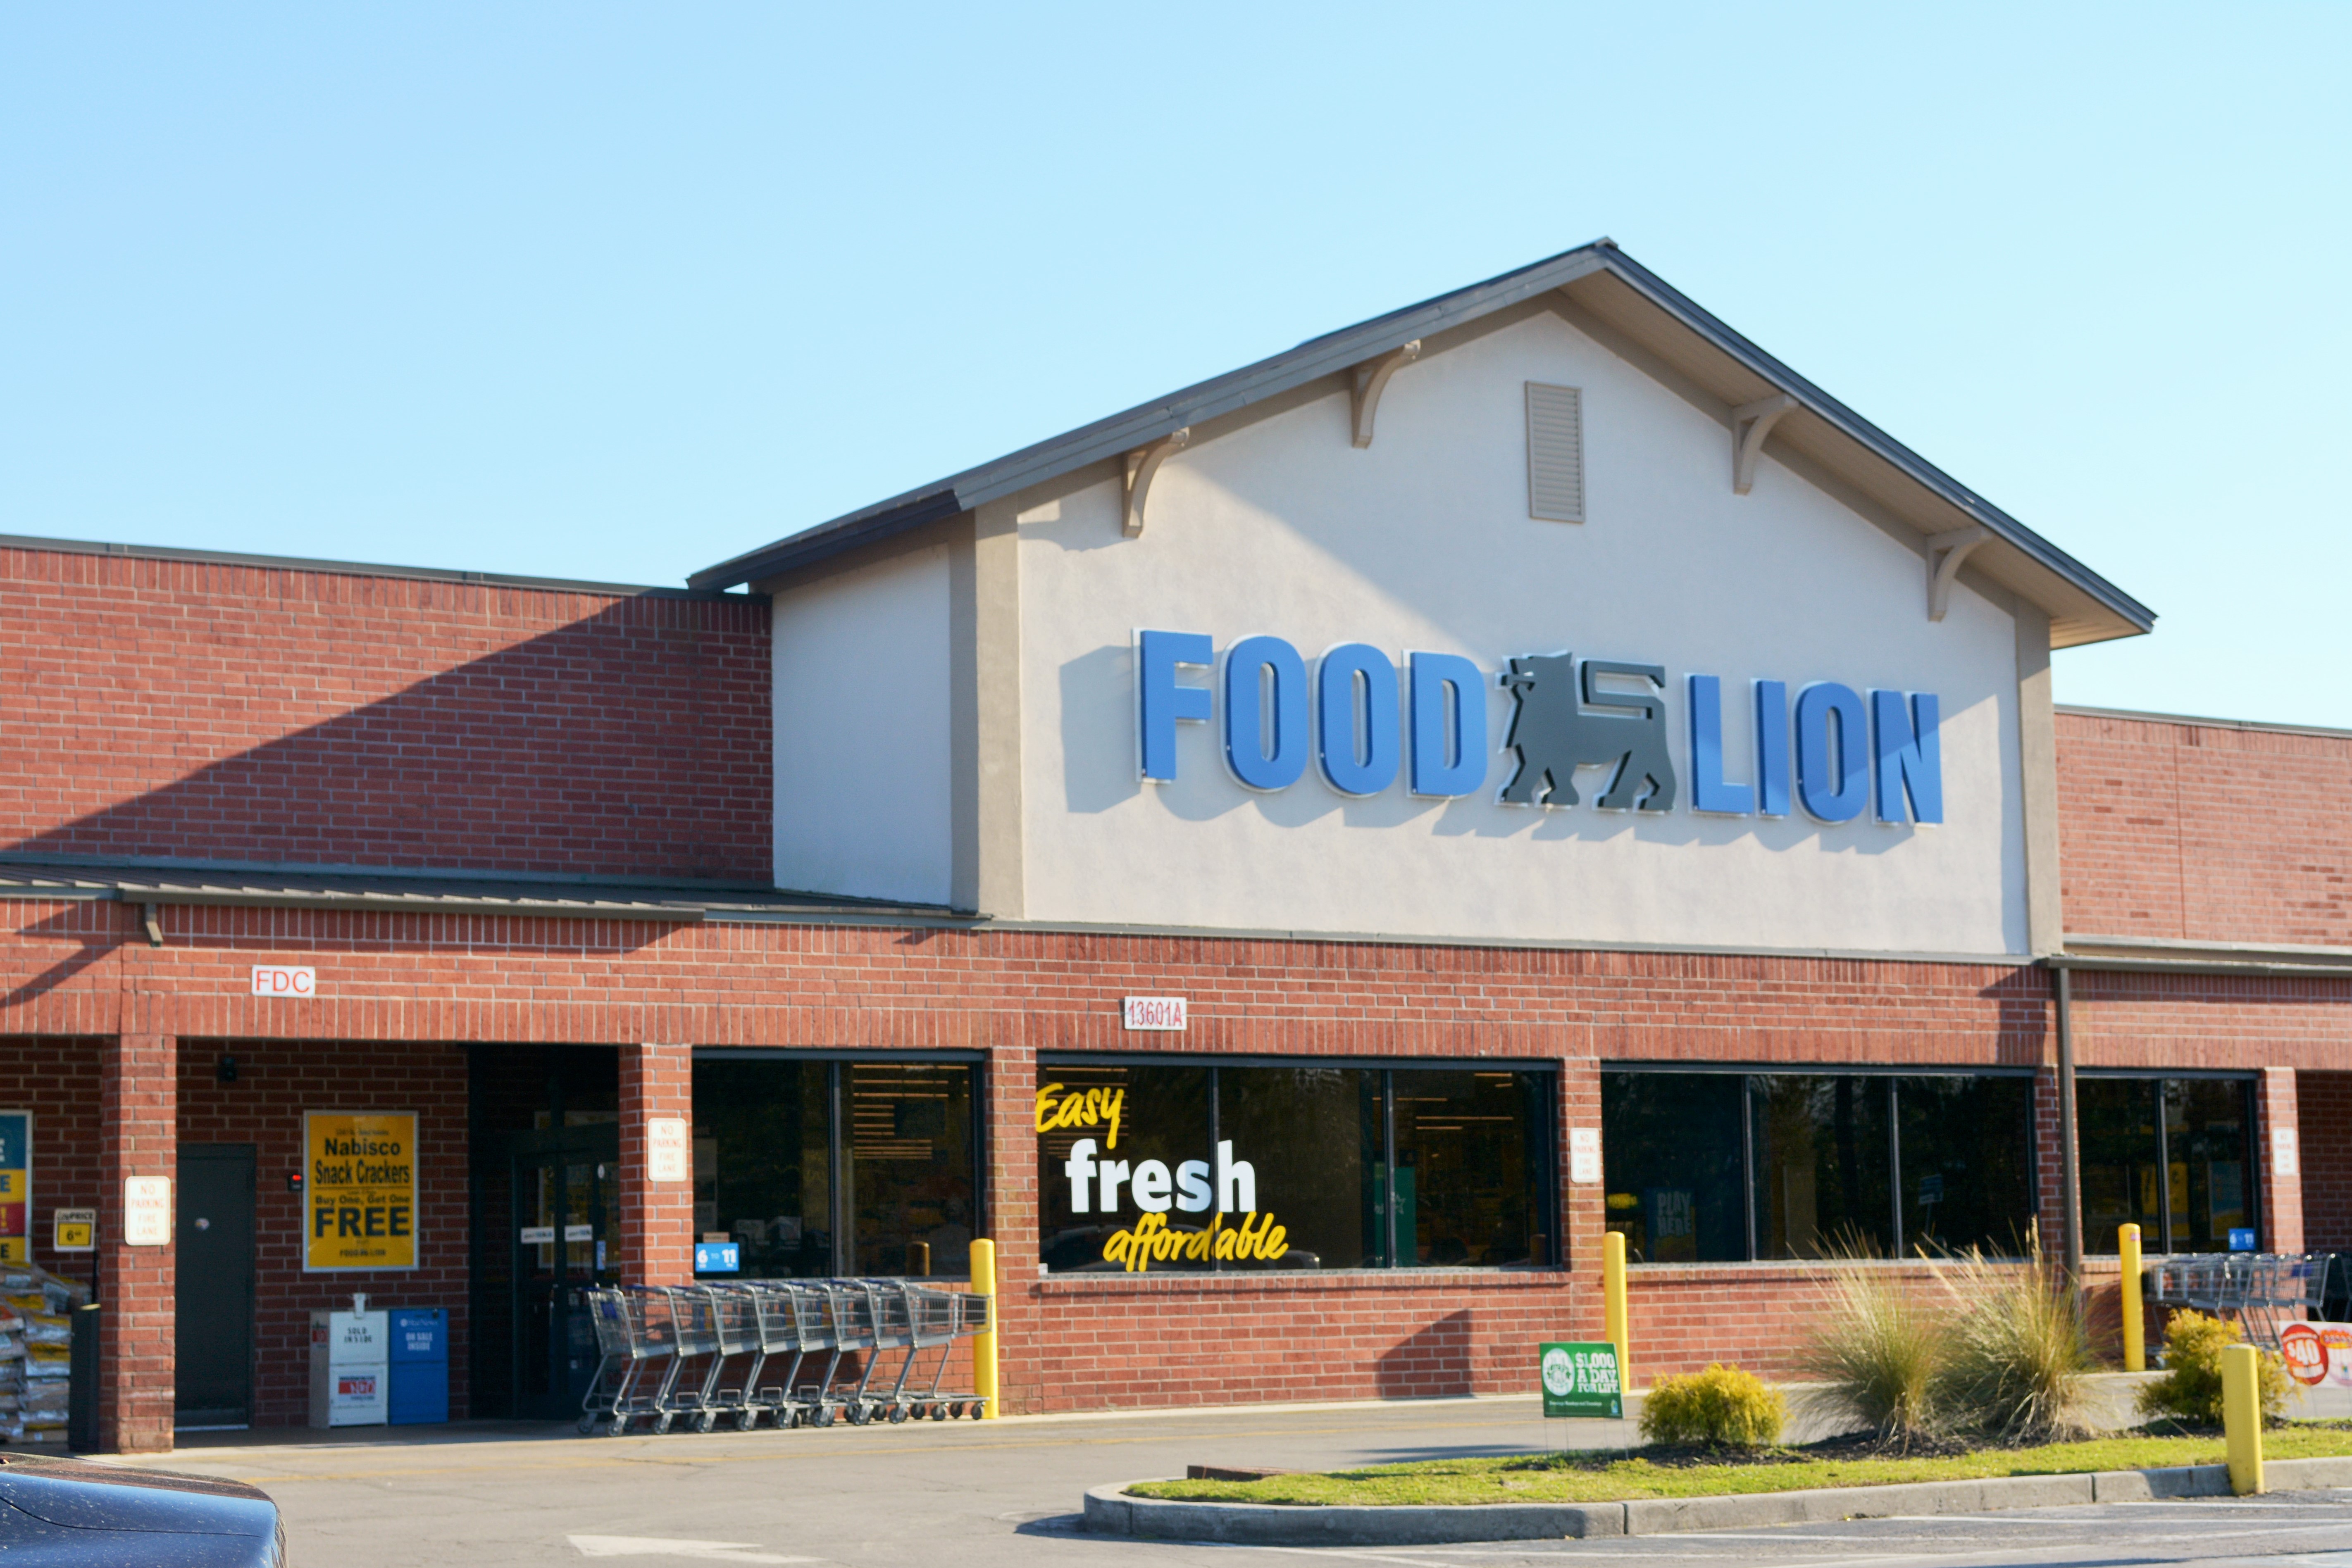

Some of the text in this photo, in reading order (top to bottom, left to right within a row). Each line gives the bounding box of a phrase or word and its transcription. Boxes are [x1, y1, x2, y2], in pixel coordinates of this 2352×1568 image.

[1134, 629, 1944, 825] FOOD LION
[257, 971, 310, 993] FDC
[1129, 1001, 1182, 1026] 13601A
[1035, 1083, 1124, 1149] Easy
[661, 1125, 674, 1135] NO
[325, 1137, 401, 1156] Nabisco
[653, 1137, 682, 1148] PARKING
[315, 1159, 410, 1184] Snack Crackers
[1065, 1138, 1256, 1213] fresh
[140, 1184, 156, 1195] NO
[131, 1198, 165, 1209] PARKING
[316, 1195, 335, 1206] Buy
[389, 1194, 410, 1203] One
[1657, 1191, 1691, 1215] PLAY
[316, 1206, 410, 1237] FREE
[1103, 1211, 1289, 1272] affordable
[697, 1249, 708, 1263] 6
[722, 1249, 736, 1263] 11
[1575, 1351, 1616, 1370] $1,000
[2286, 1339, 2321, 1366] $40
[1577, 1368, 1618, 1384] A DAY
[1578, 1383, 1597, 1393] FOR
